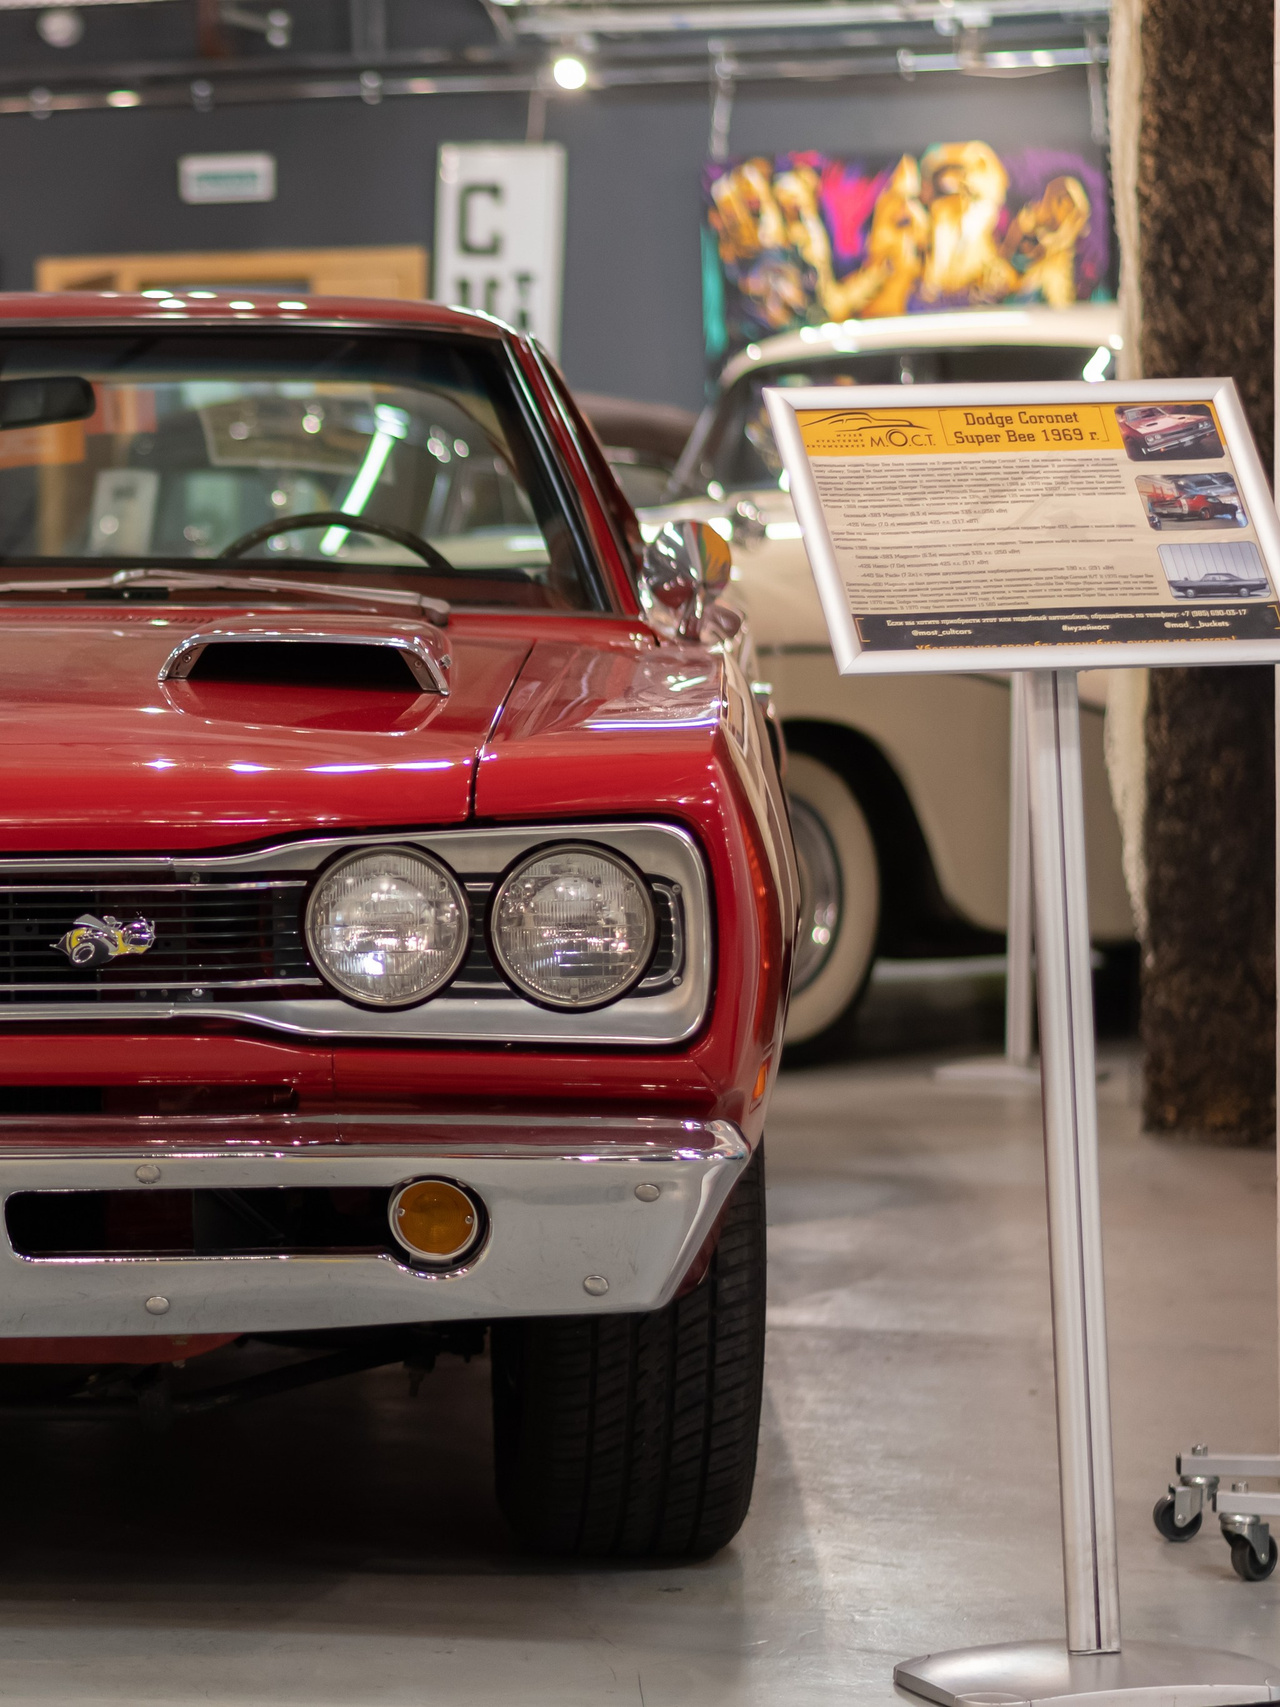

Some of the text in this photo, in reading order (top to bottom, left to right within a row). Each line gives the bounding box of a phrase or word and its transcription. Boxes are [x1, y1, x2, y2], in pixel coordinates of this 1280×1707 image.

[964, 412, 1079, 427] Dodge Coronet
[954, 431, 1001, 446] Super
[1005, 430, 1035, 442] Bee
[1042, 428, 1084, 441] 1969
